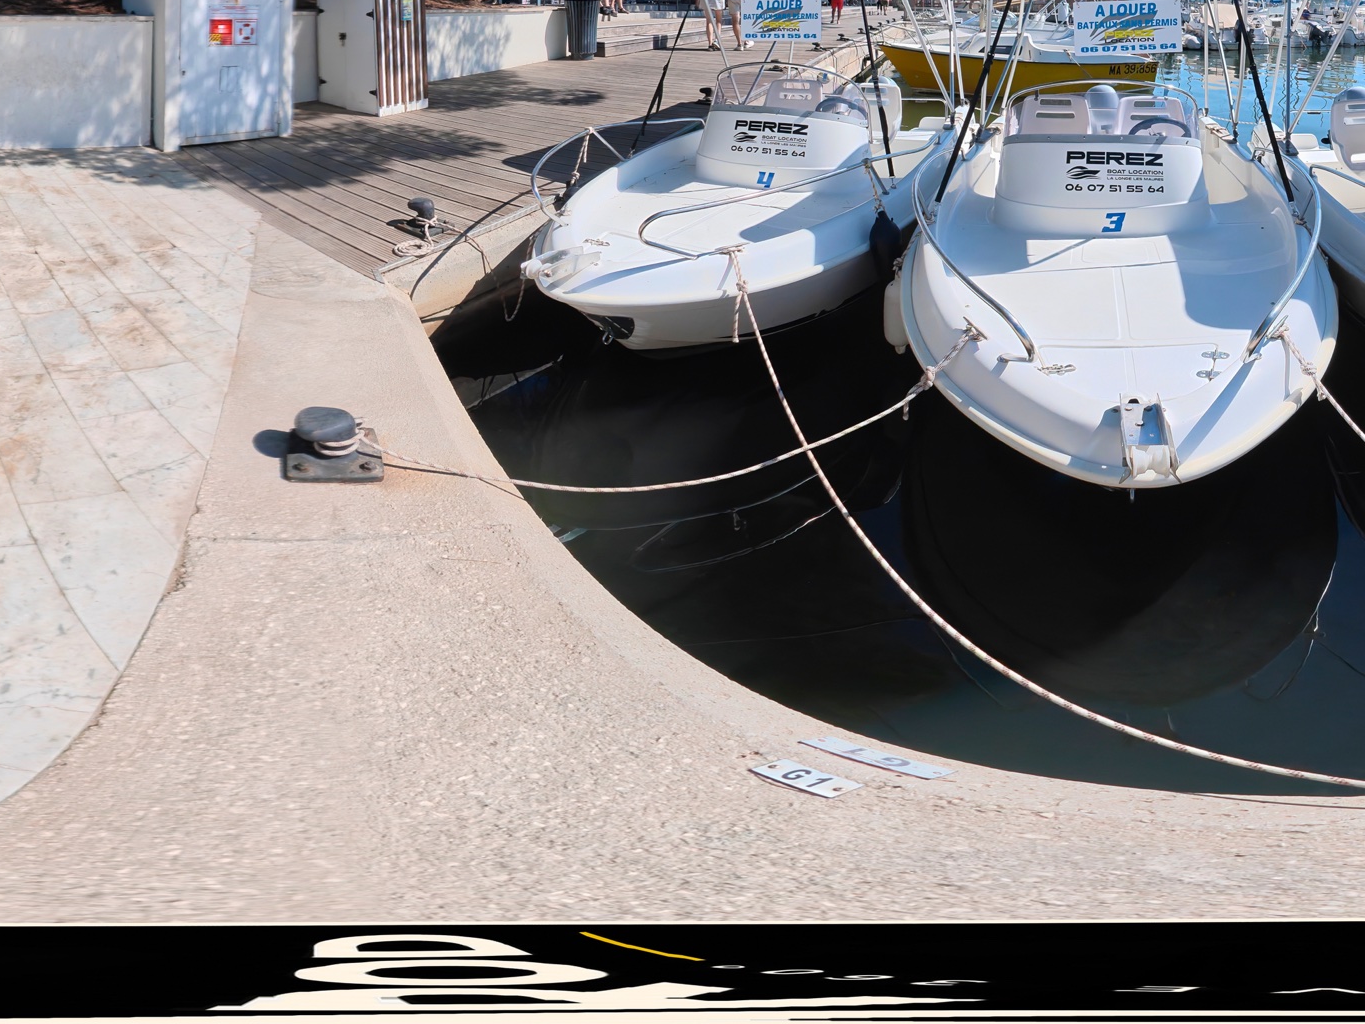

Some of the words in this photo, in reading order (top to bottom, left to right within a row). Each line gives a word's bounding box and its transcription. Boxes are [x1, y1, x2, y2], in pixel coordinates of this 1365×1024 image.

[756, 0, 763, 10] A
[767, 0, 803, 10] LOUER
[1095, 4, 1105, 17] A
[1110, 2, 1157, 16] LOUER
[1077, 21, 1118, 30] BATEAUX
[1144, 18, 1178, 27] PERMIS
[1104, 30, 1155, 39] PEREZ
[1109, 65, 1121, 75] MA
[734, 120, 809, 135] PEREZ
[1066, 150, 1164, 167] PEREZ
[756, 171, 775, 188] 4
[1065, 184, 1083, 192] 06
[1101, 212, 1126, 233] 3
[781, 768, 834, 788] G1
